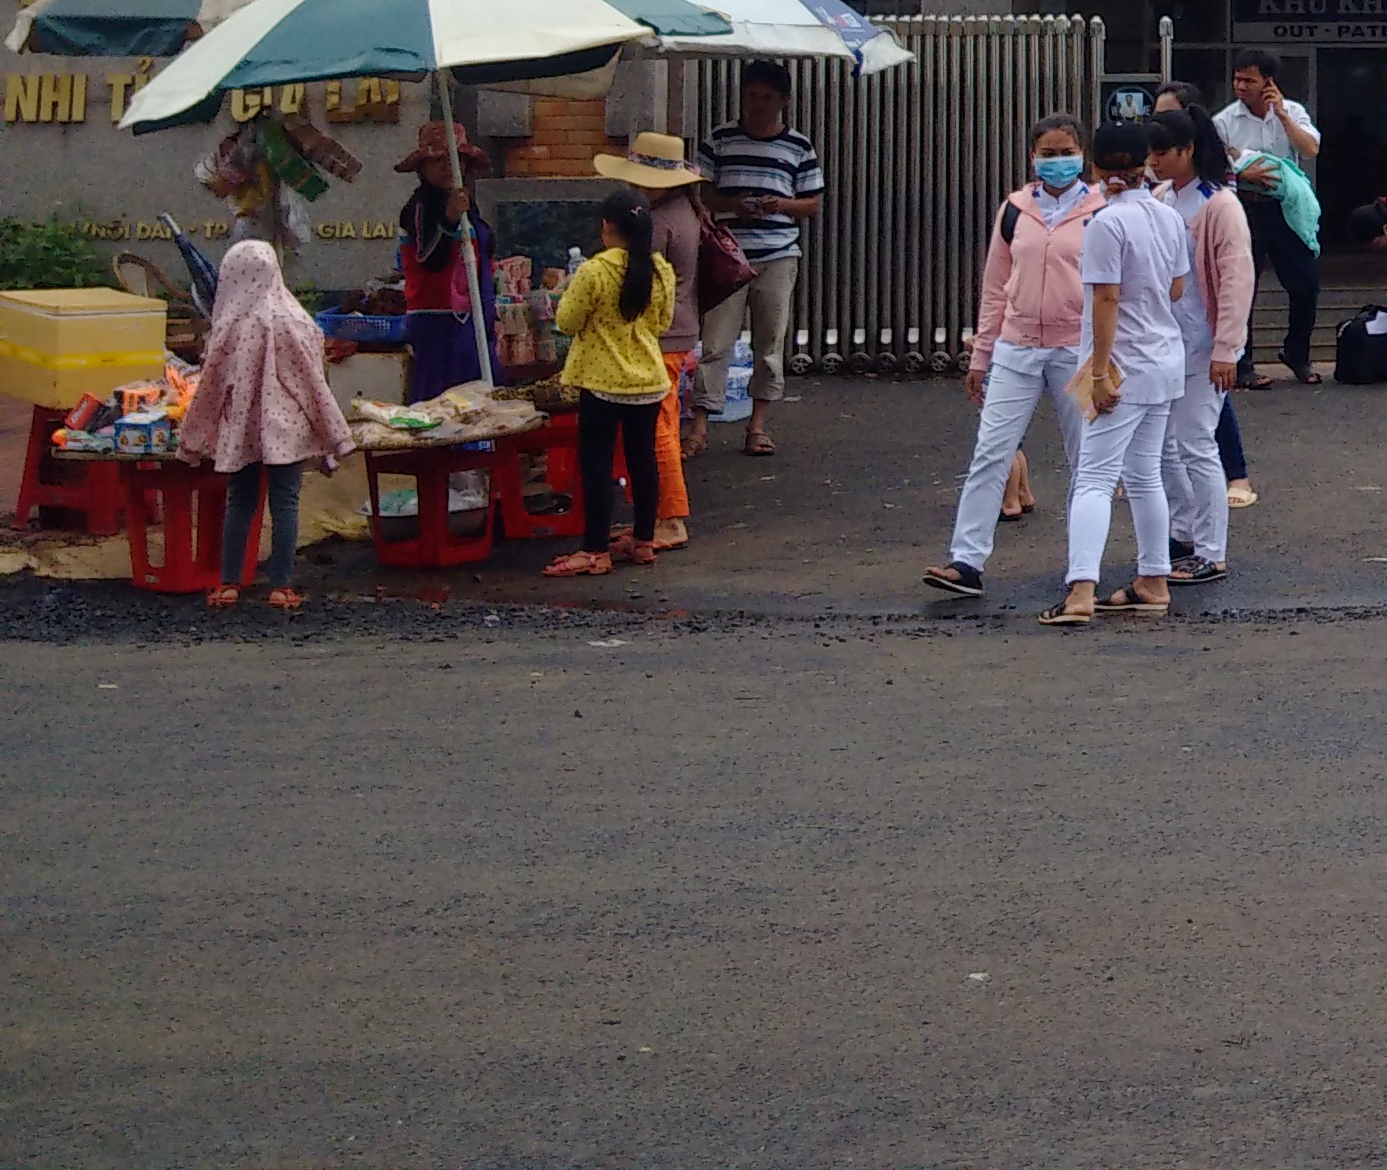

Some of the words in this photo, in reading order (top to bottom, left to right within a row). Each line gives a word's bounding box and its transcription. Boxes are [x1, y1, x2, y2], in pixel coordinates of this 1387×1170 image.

[1273, 25, 1319, 38] OUT
[5, 73, 88, 123] NHI
[317, 221, 355, 239] GIA
[360, 221, 394, 239] LAI
